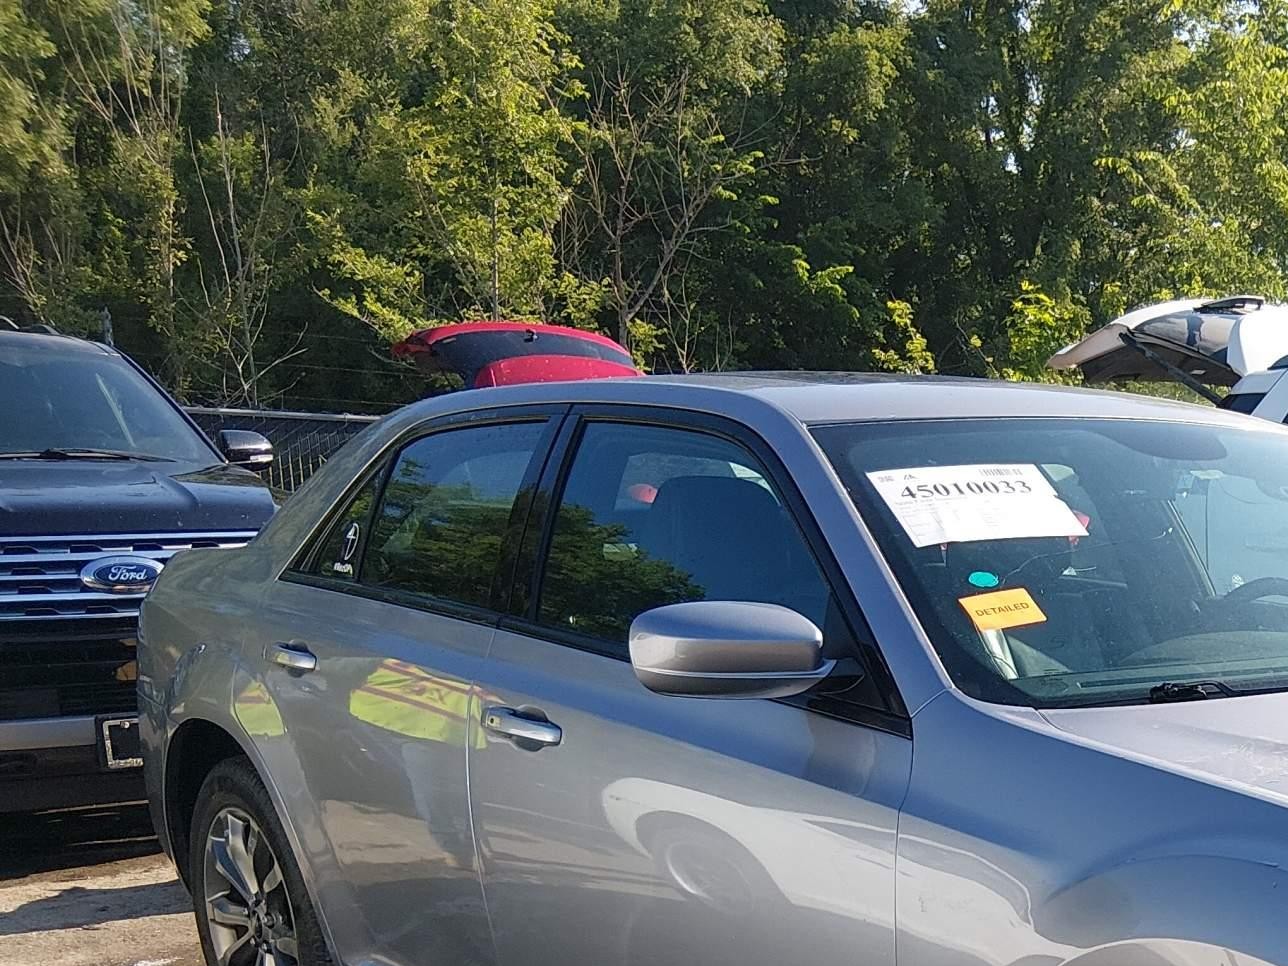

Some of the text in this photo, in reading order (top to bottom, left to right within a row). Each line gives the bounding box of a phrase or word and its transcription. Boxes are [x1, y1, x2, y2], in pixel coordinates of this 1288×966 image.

[901, 480, 1032, 499] 45010033
[108, 566, 147, 581] Ford
[975, 602, 1030, 617] DETAILED
